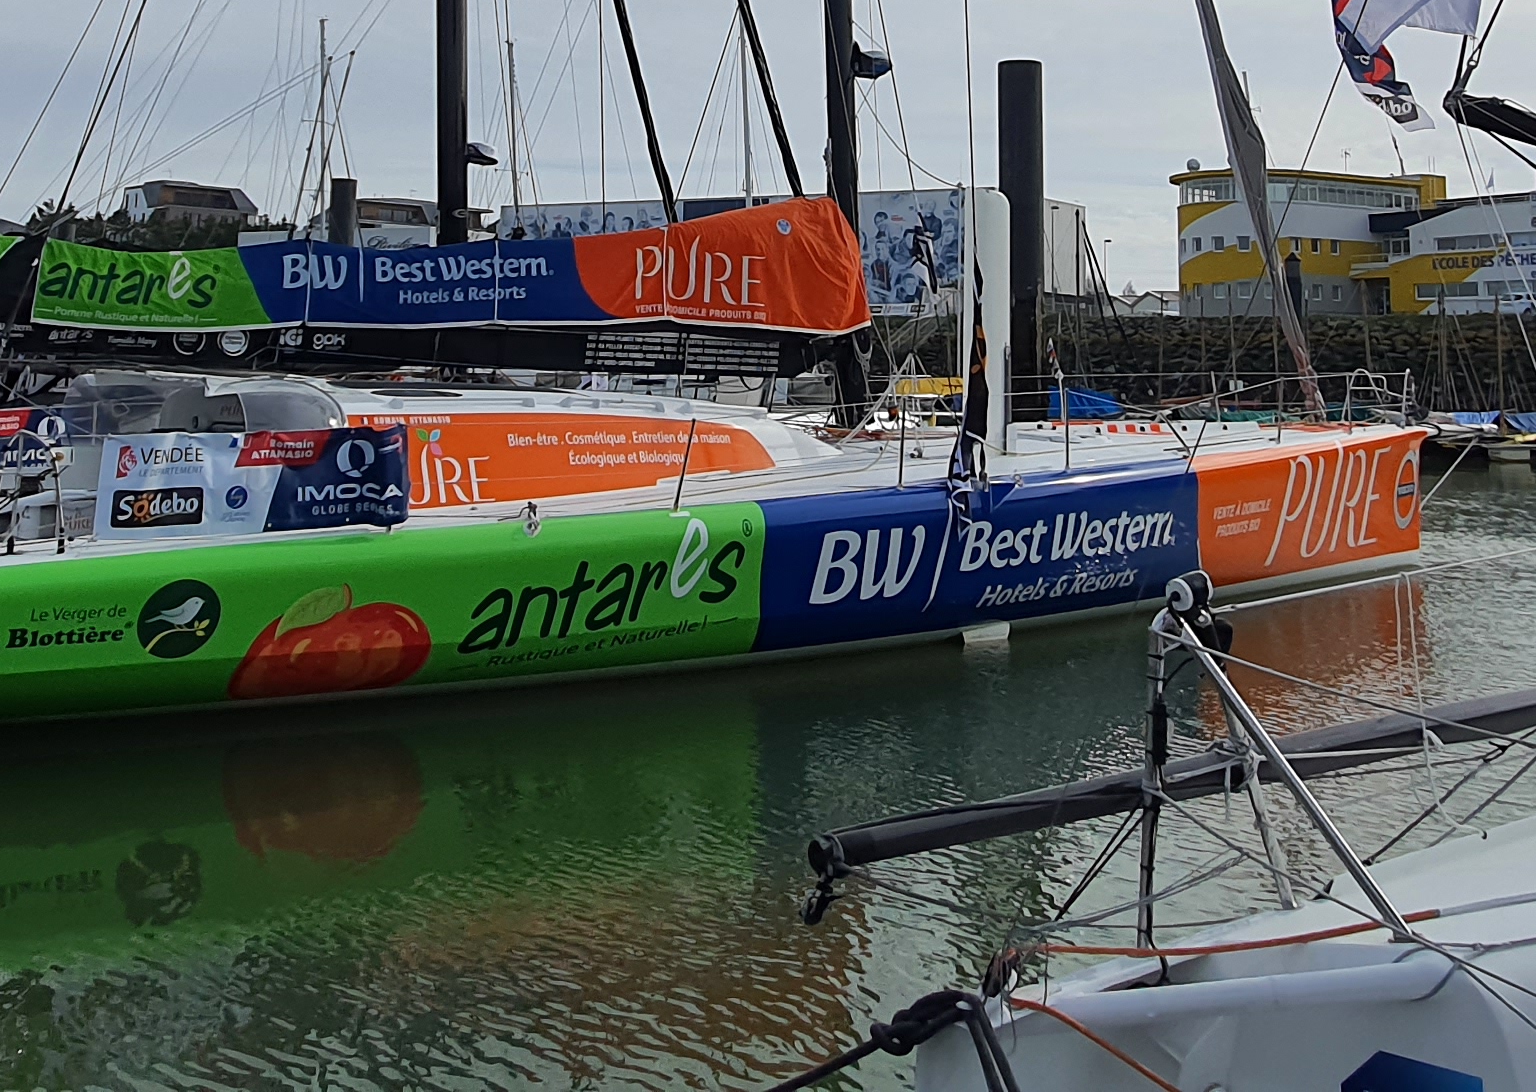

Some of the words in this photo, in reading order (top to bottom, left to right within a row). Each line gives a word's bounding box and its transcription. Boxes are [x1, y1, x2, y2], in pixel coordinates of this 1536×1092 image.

[635, 234, 766, 307] PURE
[1471, 255, 1495, 268] DES
[282, 254, 348, 290] BW
[375, 256, 435, 283] Best
[399, 288, 449, 304] Hotels
[452, 288, 464, 301] &
[468, 285, 526, 301] Resorts
[54, 306, 92, 319] Pomme
[94, 309, 138, 321] Rustique
[140, 312, 150, 322] et
[635, 304, 664, 314] VENTE
[709, 308, 752, 320] PRODUITS
[270, 438, 314, 449] Romain
[565, 429, 627, 448] Cosmétique
[632, 428, 677, 445] Entretien
[700, 431, 731, 445] maison
[141, 443, 204, 465] VENDÉE
[251, 448, 314, 460] ATTANASIO
[568, 448, 626, 466] Écologique
[628, 452, 638, 464] et
[640, 448, 685, 466] Biologiqu
[297, 482, 404, 502] IMOCA
[116, 493, 200, 521] Sodebo
[312, 502, 350, 516] GLOBE
[1213, 503, 1236, 520] VENTE
[1264, 439, 1392, 567] PURE
[959, 518, 1048, 572] Best
[808, 524, 926, 605] BW
[976, 576, 1048, 608] Hotels
[1049, 575, 1066, 598] &
[1068, 567, 1139, 596] Resorts
[30, 607, 50, 623] Le
[52, 606, 104, 624] Verger
[107, 604, 127, 618] de
[486, 644, 580, 668] Rustique
[584, 637, 607, 652] et
